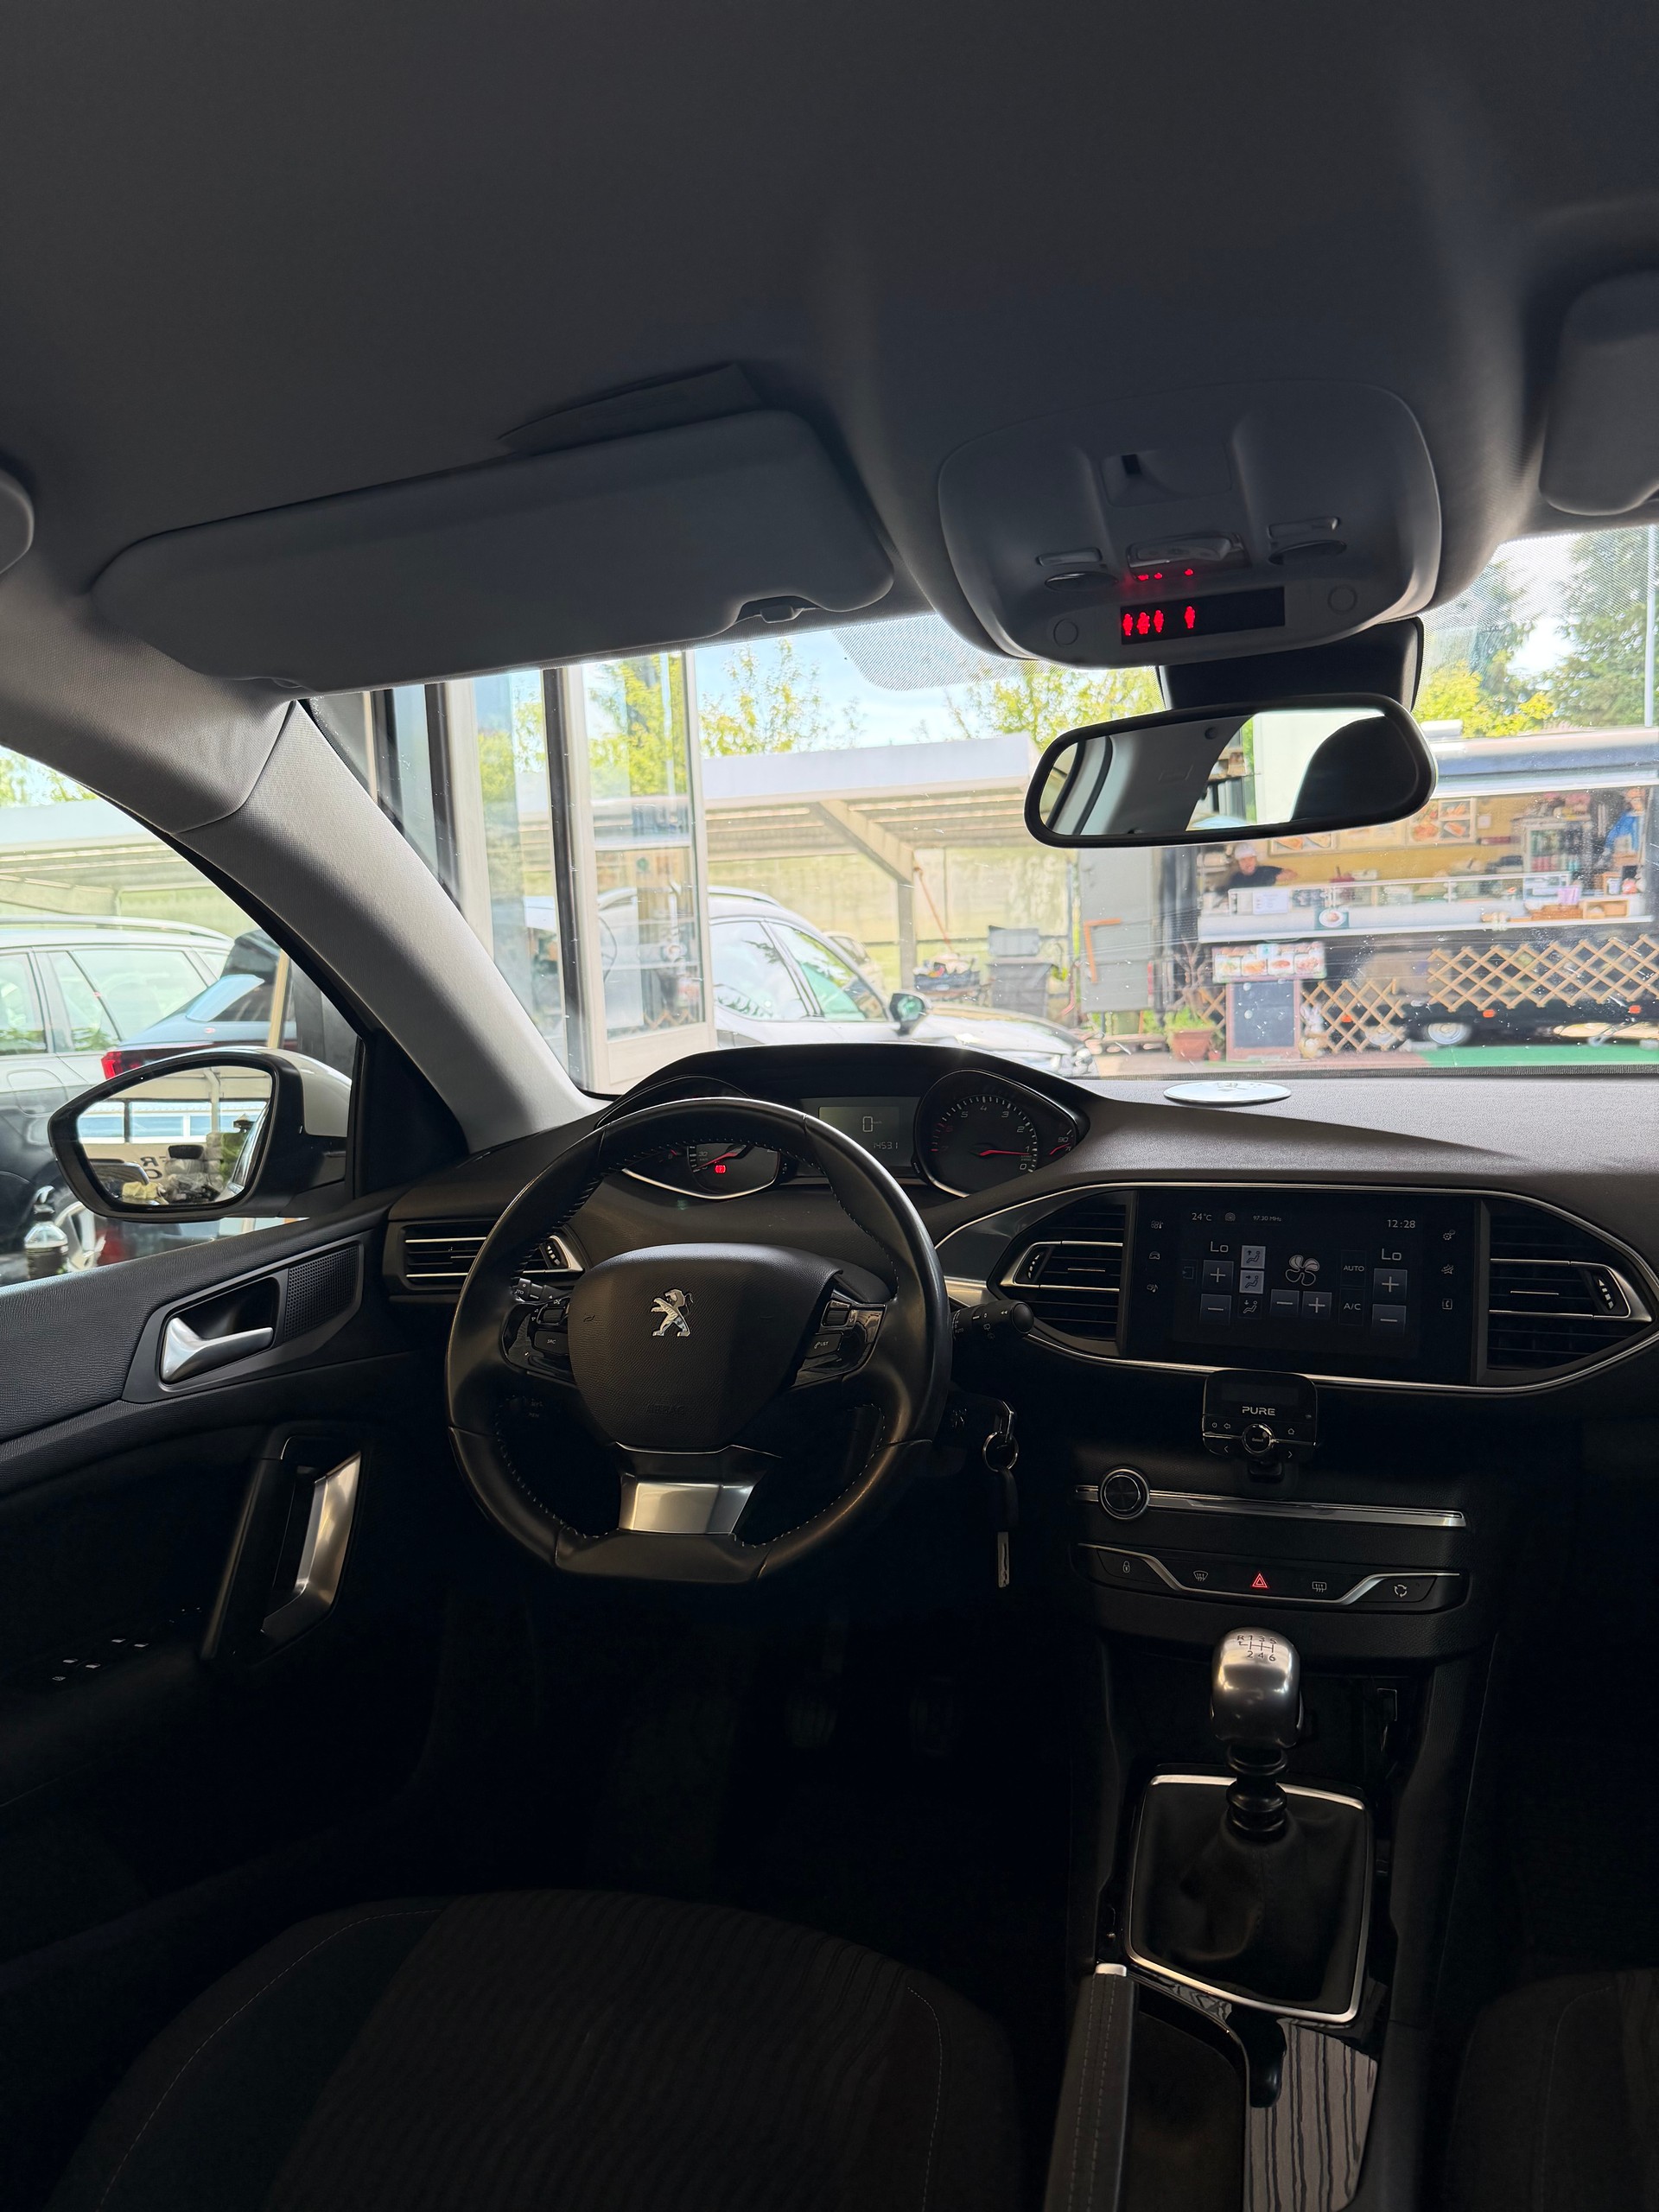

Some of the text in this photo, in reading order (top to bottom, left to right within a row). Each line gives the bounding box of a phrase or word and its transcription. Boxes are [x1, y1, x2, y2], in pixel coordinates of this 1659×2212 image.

[862, 1116, 873, 1132] 0
[1191, 1212, 1212, 1222] 24°C
[1387, 1219, 1416, 1229] 12:28
[1210, 1240, 1229, 1253] Lo
[1382, 1248, 1402, 1261] Lo
[1343, 1302, 1362, 1311] A/C
[1242, 1406, 1276, 1416] PURE
